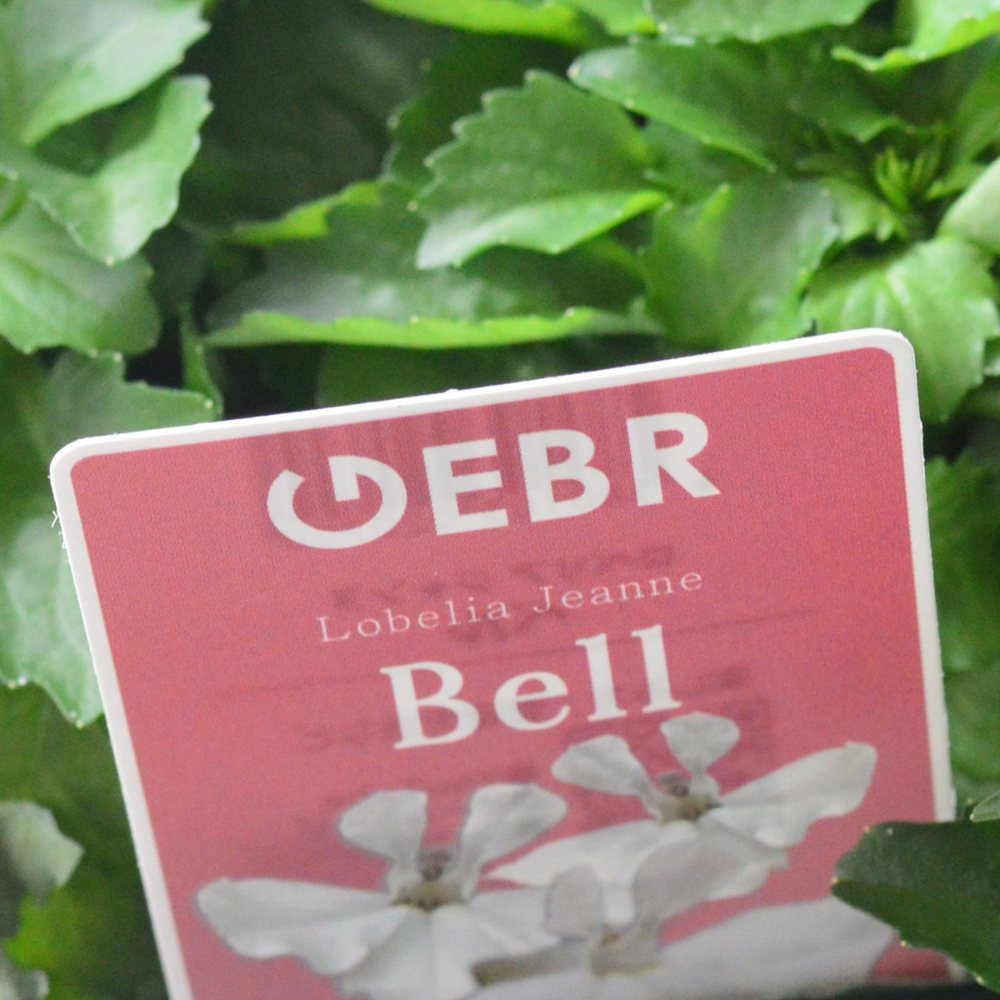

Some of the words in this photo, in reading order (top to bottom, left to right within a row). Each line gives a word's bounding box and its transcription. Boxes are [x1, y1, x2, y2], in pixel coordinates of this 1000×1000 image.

[317, 594, 512, 643] Lobelia
[532, 570, 704, 616] Jeanne
[378, 624, 682, 750] Bell
